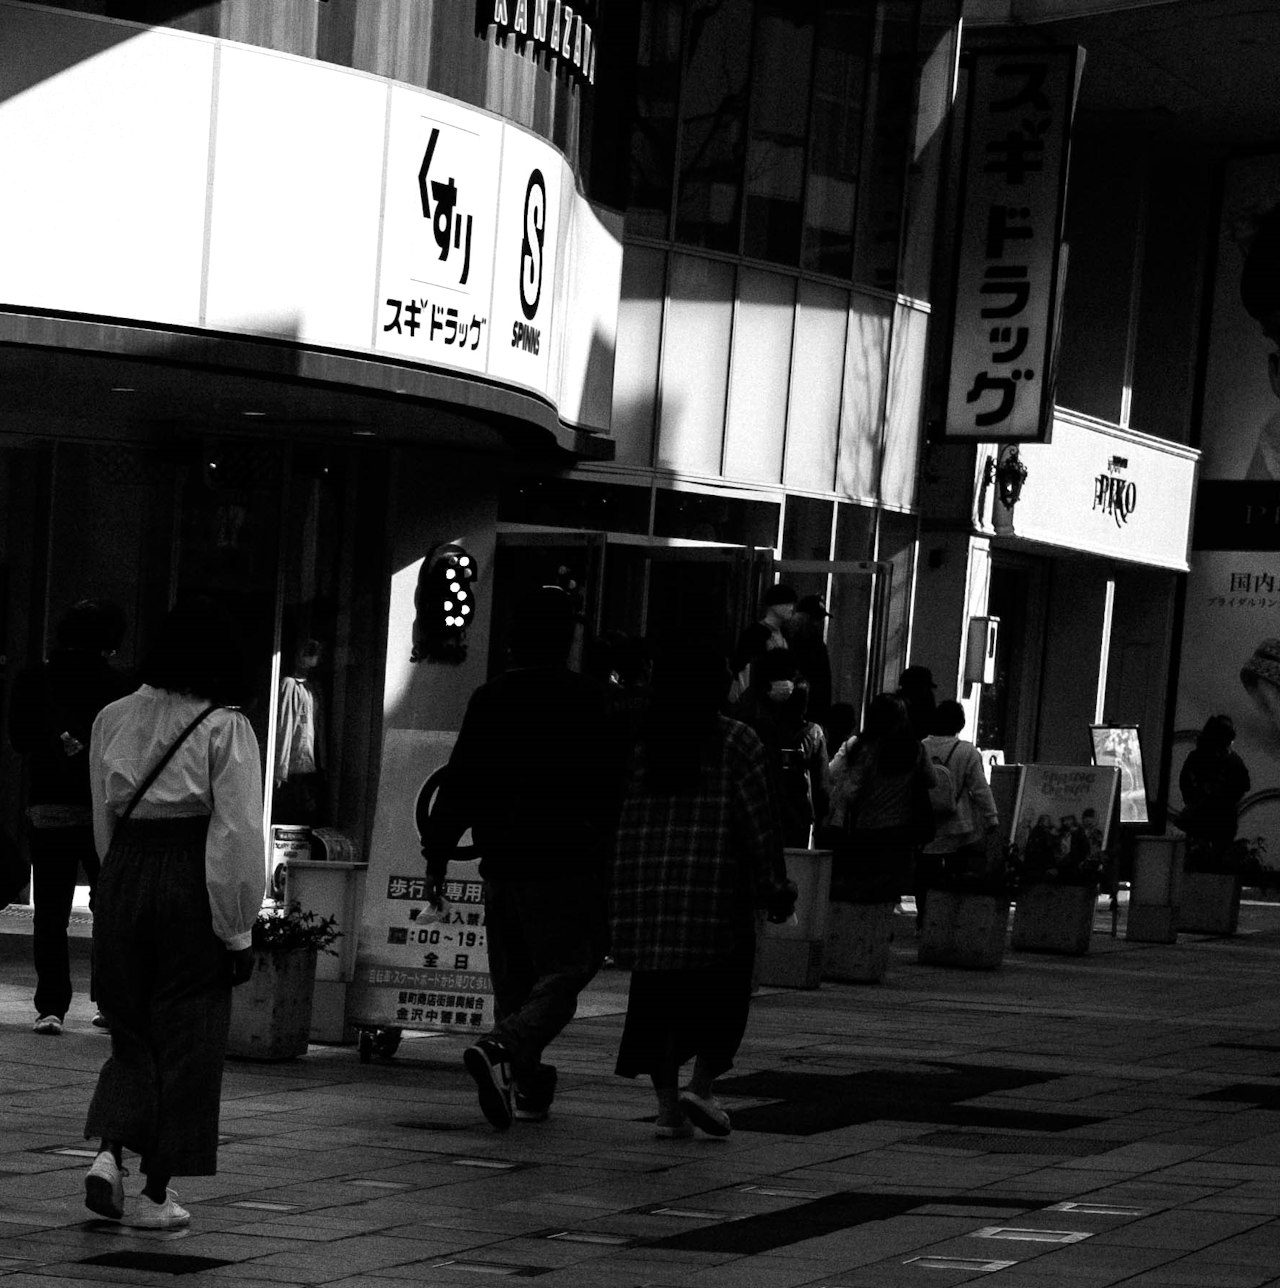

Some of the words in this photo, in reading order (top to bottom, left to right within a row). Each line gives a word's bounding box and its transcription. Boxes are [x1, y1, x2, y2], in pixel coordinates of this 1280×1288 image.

[418, 127, 473, 285] くすり
[966, 62, 1052, 427] スギドラッグ
[383, 298, 486, 350] スギドラッグ
[511, 320, 541, 356] SPINNS
[1230, 572, 1280, 593] 国内
[390, 879, 482, 902] 歩行専用
